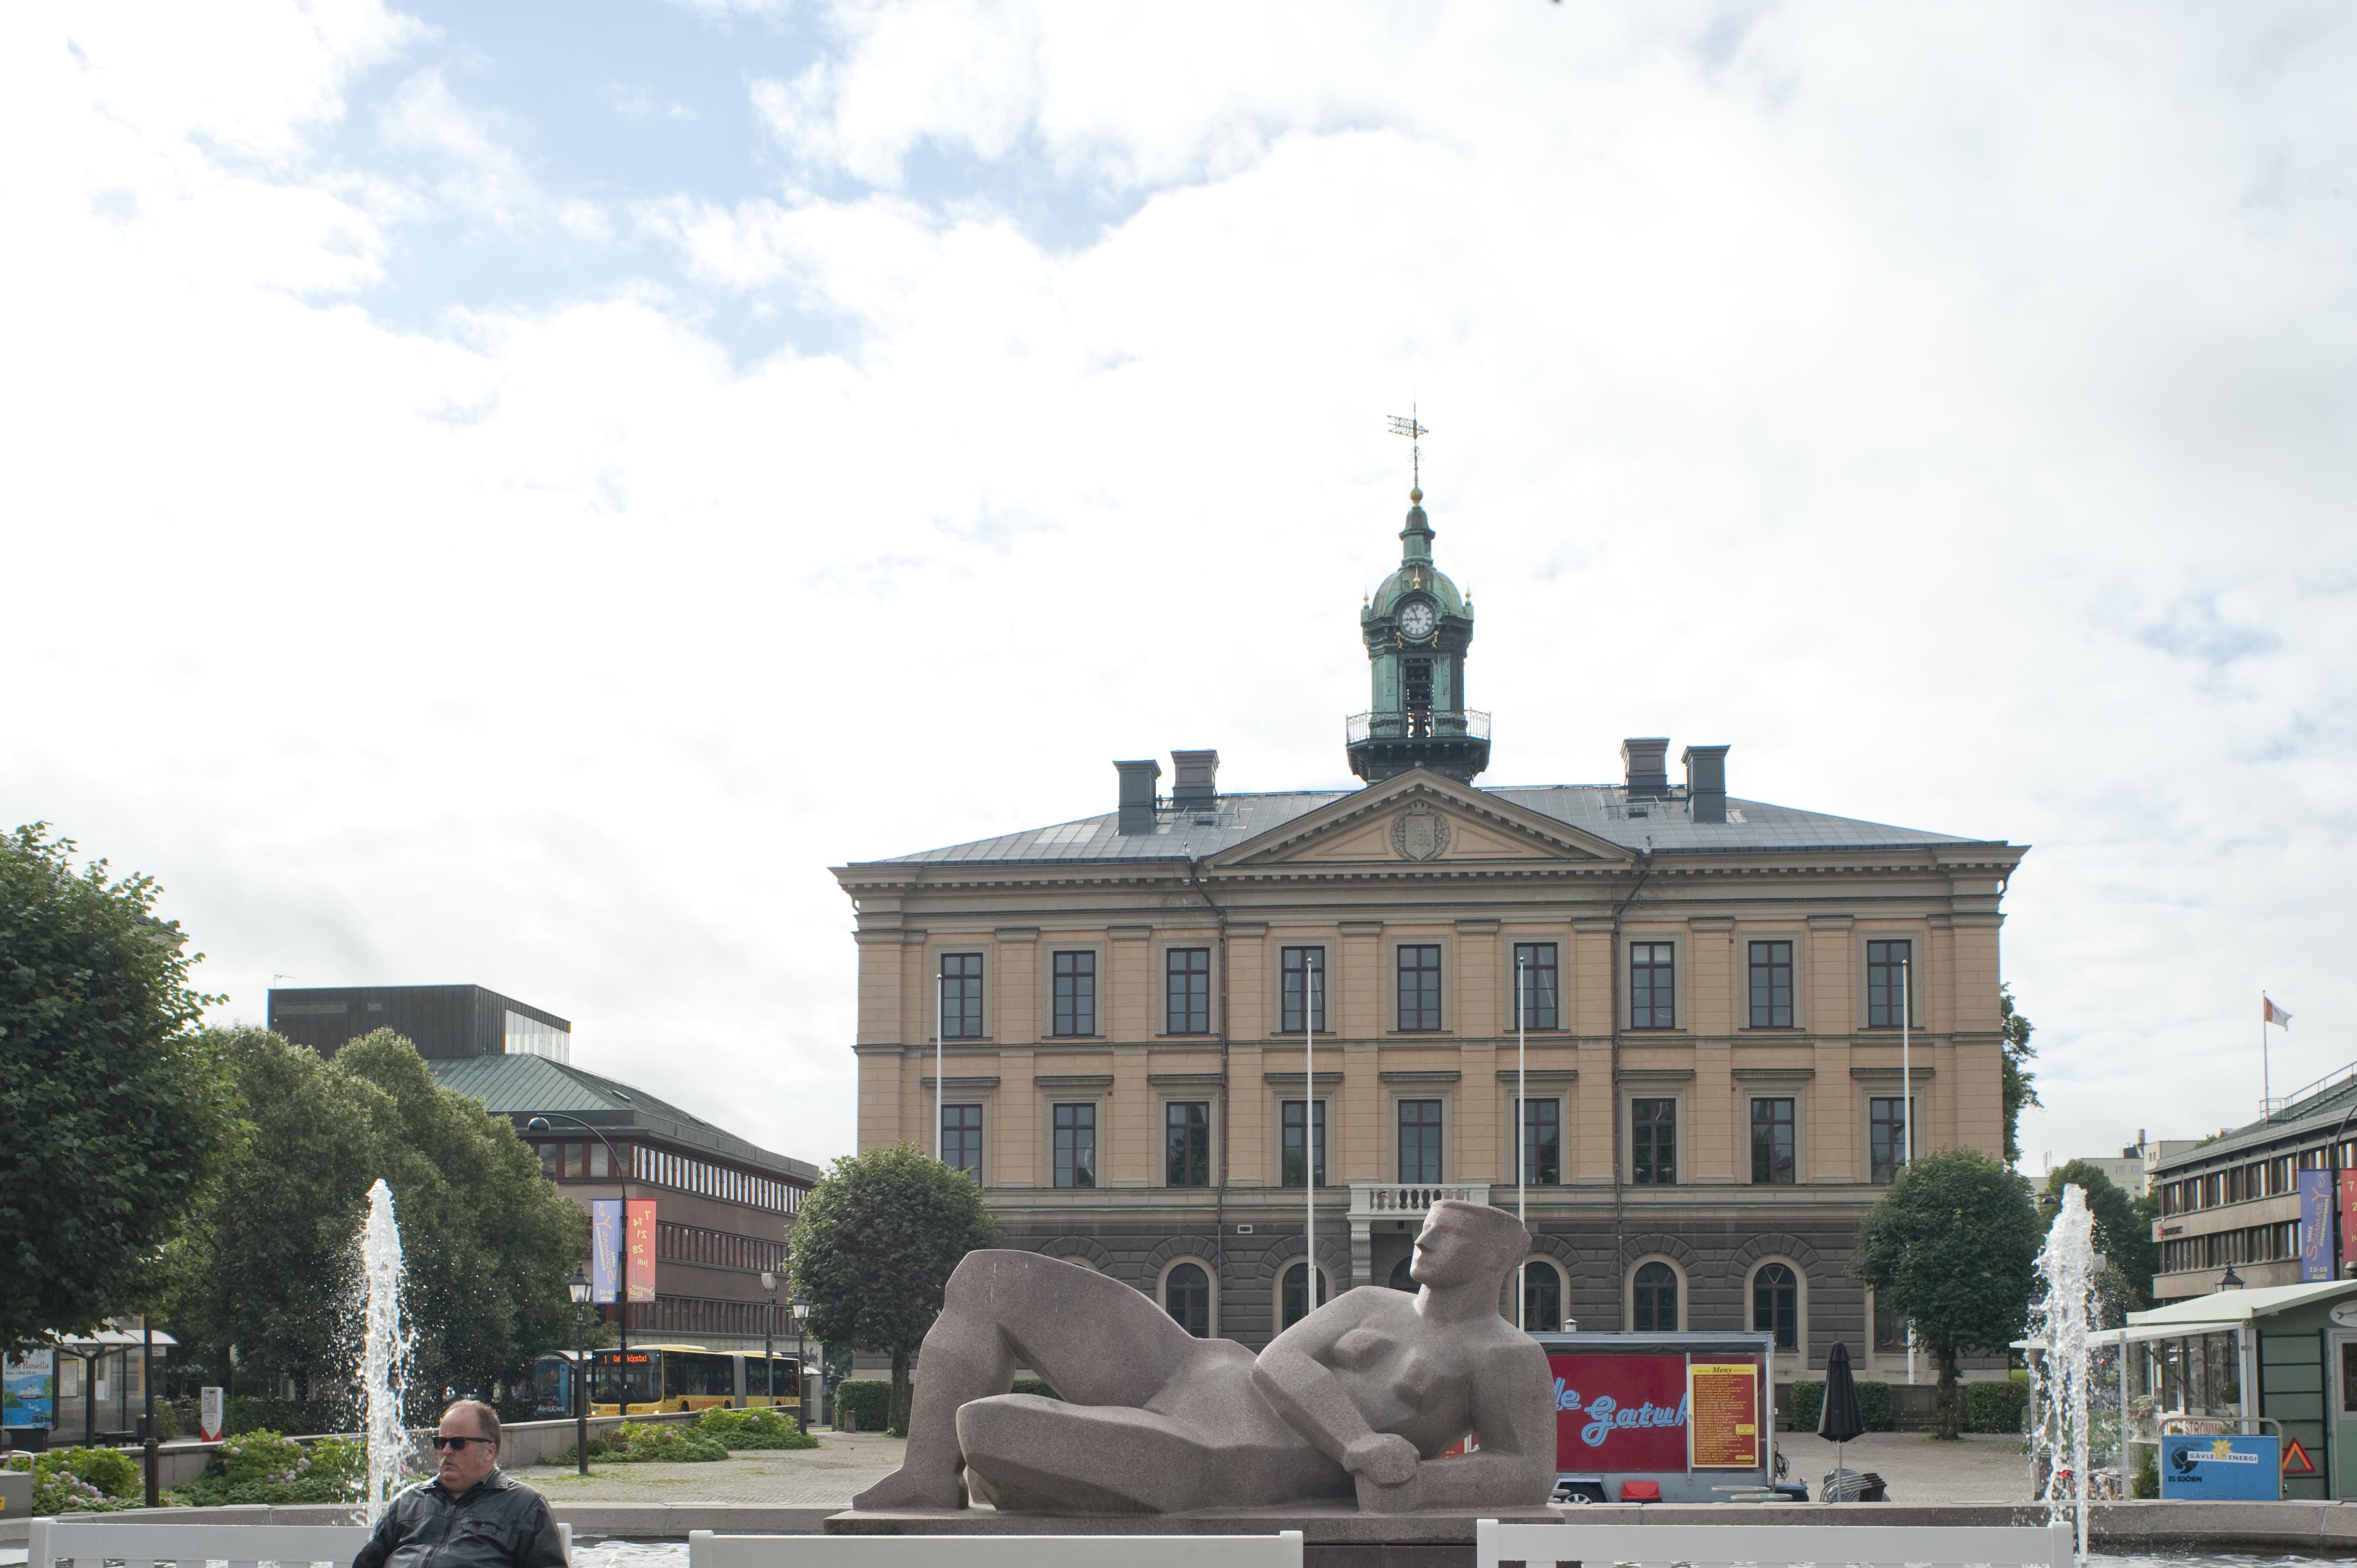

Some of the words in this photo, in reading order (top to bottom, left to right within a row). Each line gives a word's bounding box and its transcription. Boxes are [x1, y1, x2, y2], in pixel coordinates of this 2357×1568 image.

[2347, 1180, 2354, 1192] 7
[23, 1360, 49, 1369] Rosella
[1554, 1376, 1582, 1411] le
